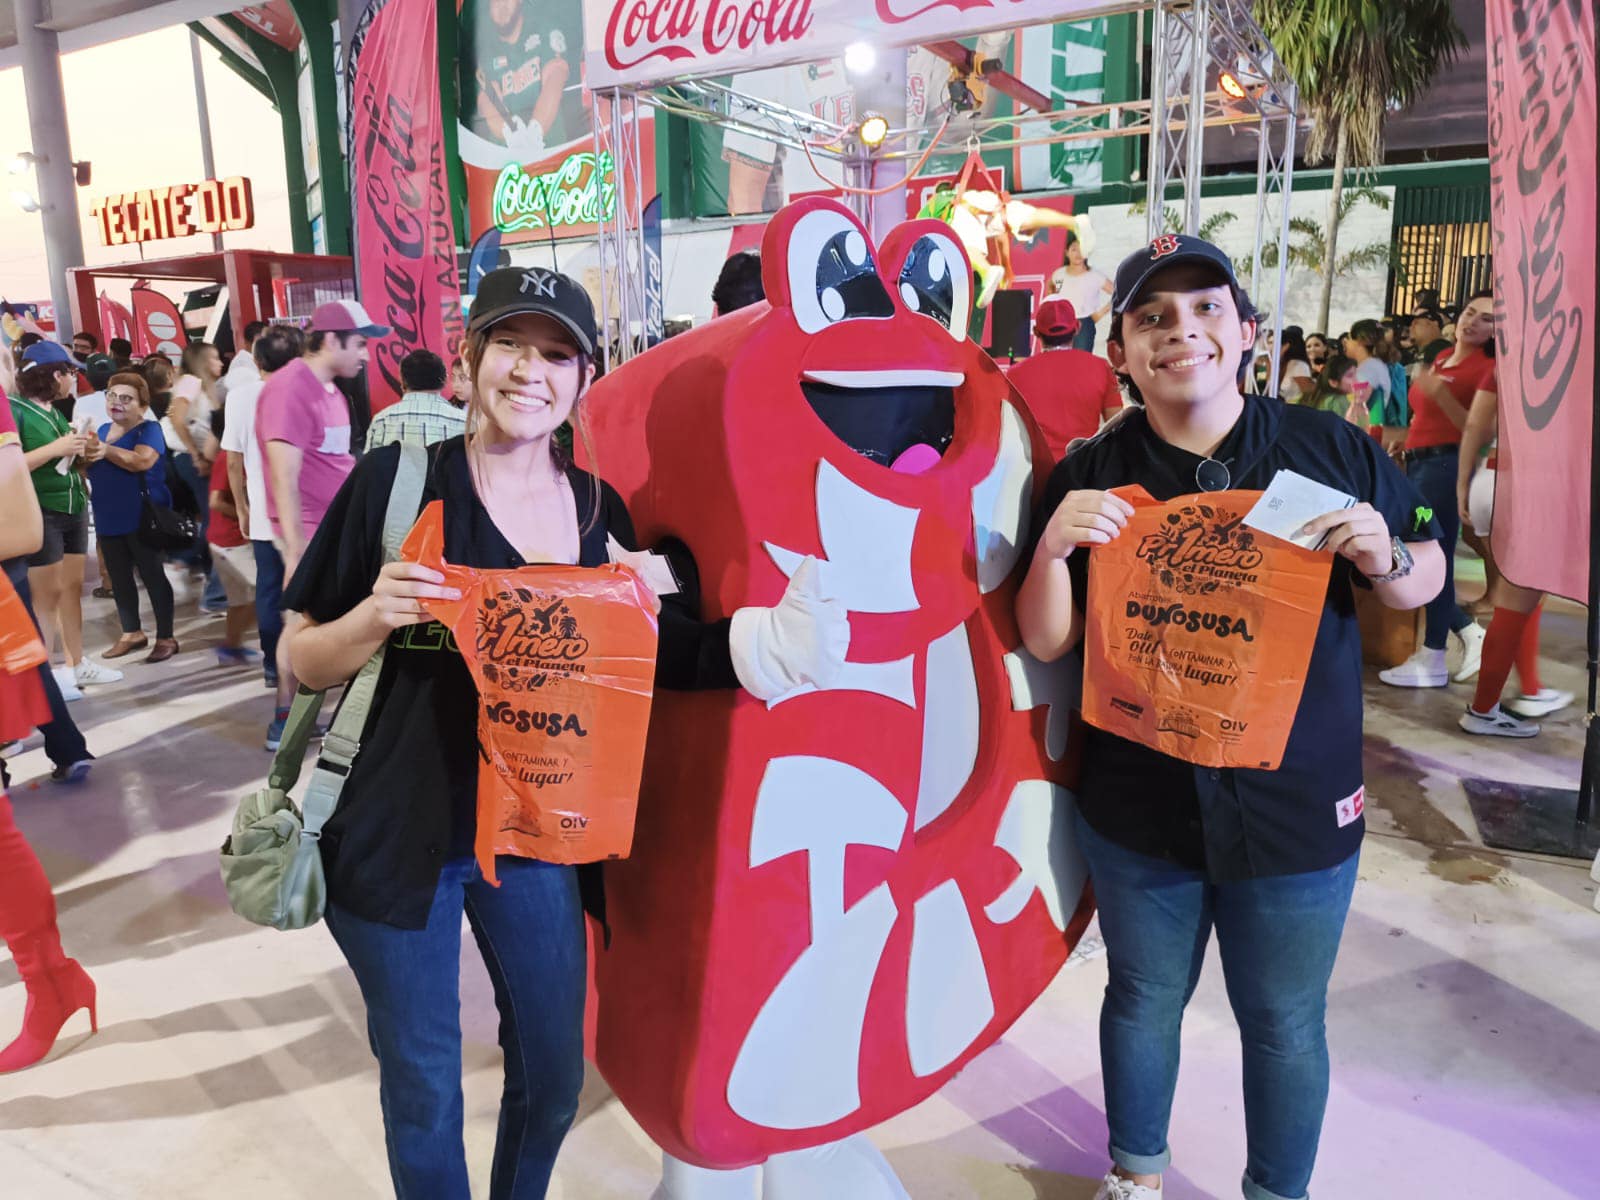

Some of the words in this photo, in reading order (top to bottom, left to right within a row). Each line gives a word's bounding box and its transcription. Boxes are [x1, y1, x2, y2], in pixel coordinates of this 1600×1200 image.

[604, 0, 815, 71] CocaCola
[89, 183, 197, 247] TECATE
[1149, 233, 1182, 260] B
[519, 270, 558, 299] NY
[439, 301, 464, 357] SIN
[1199, 564, 1258, 583] Planeta
[1126, 601, 1254, 642] DUNOSUSA
[523, 659, 587, 674] Planeta
[485, 700, 588, 737] NOSUSA
